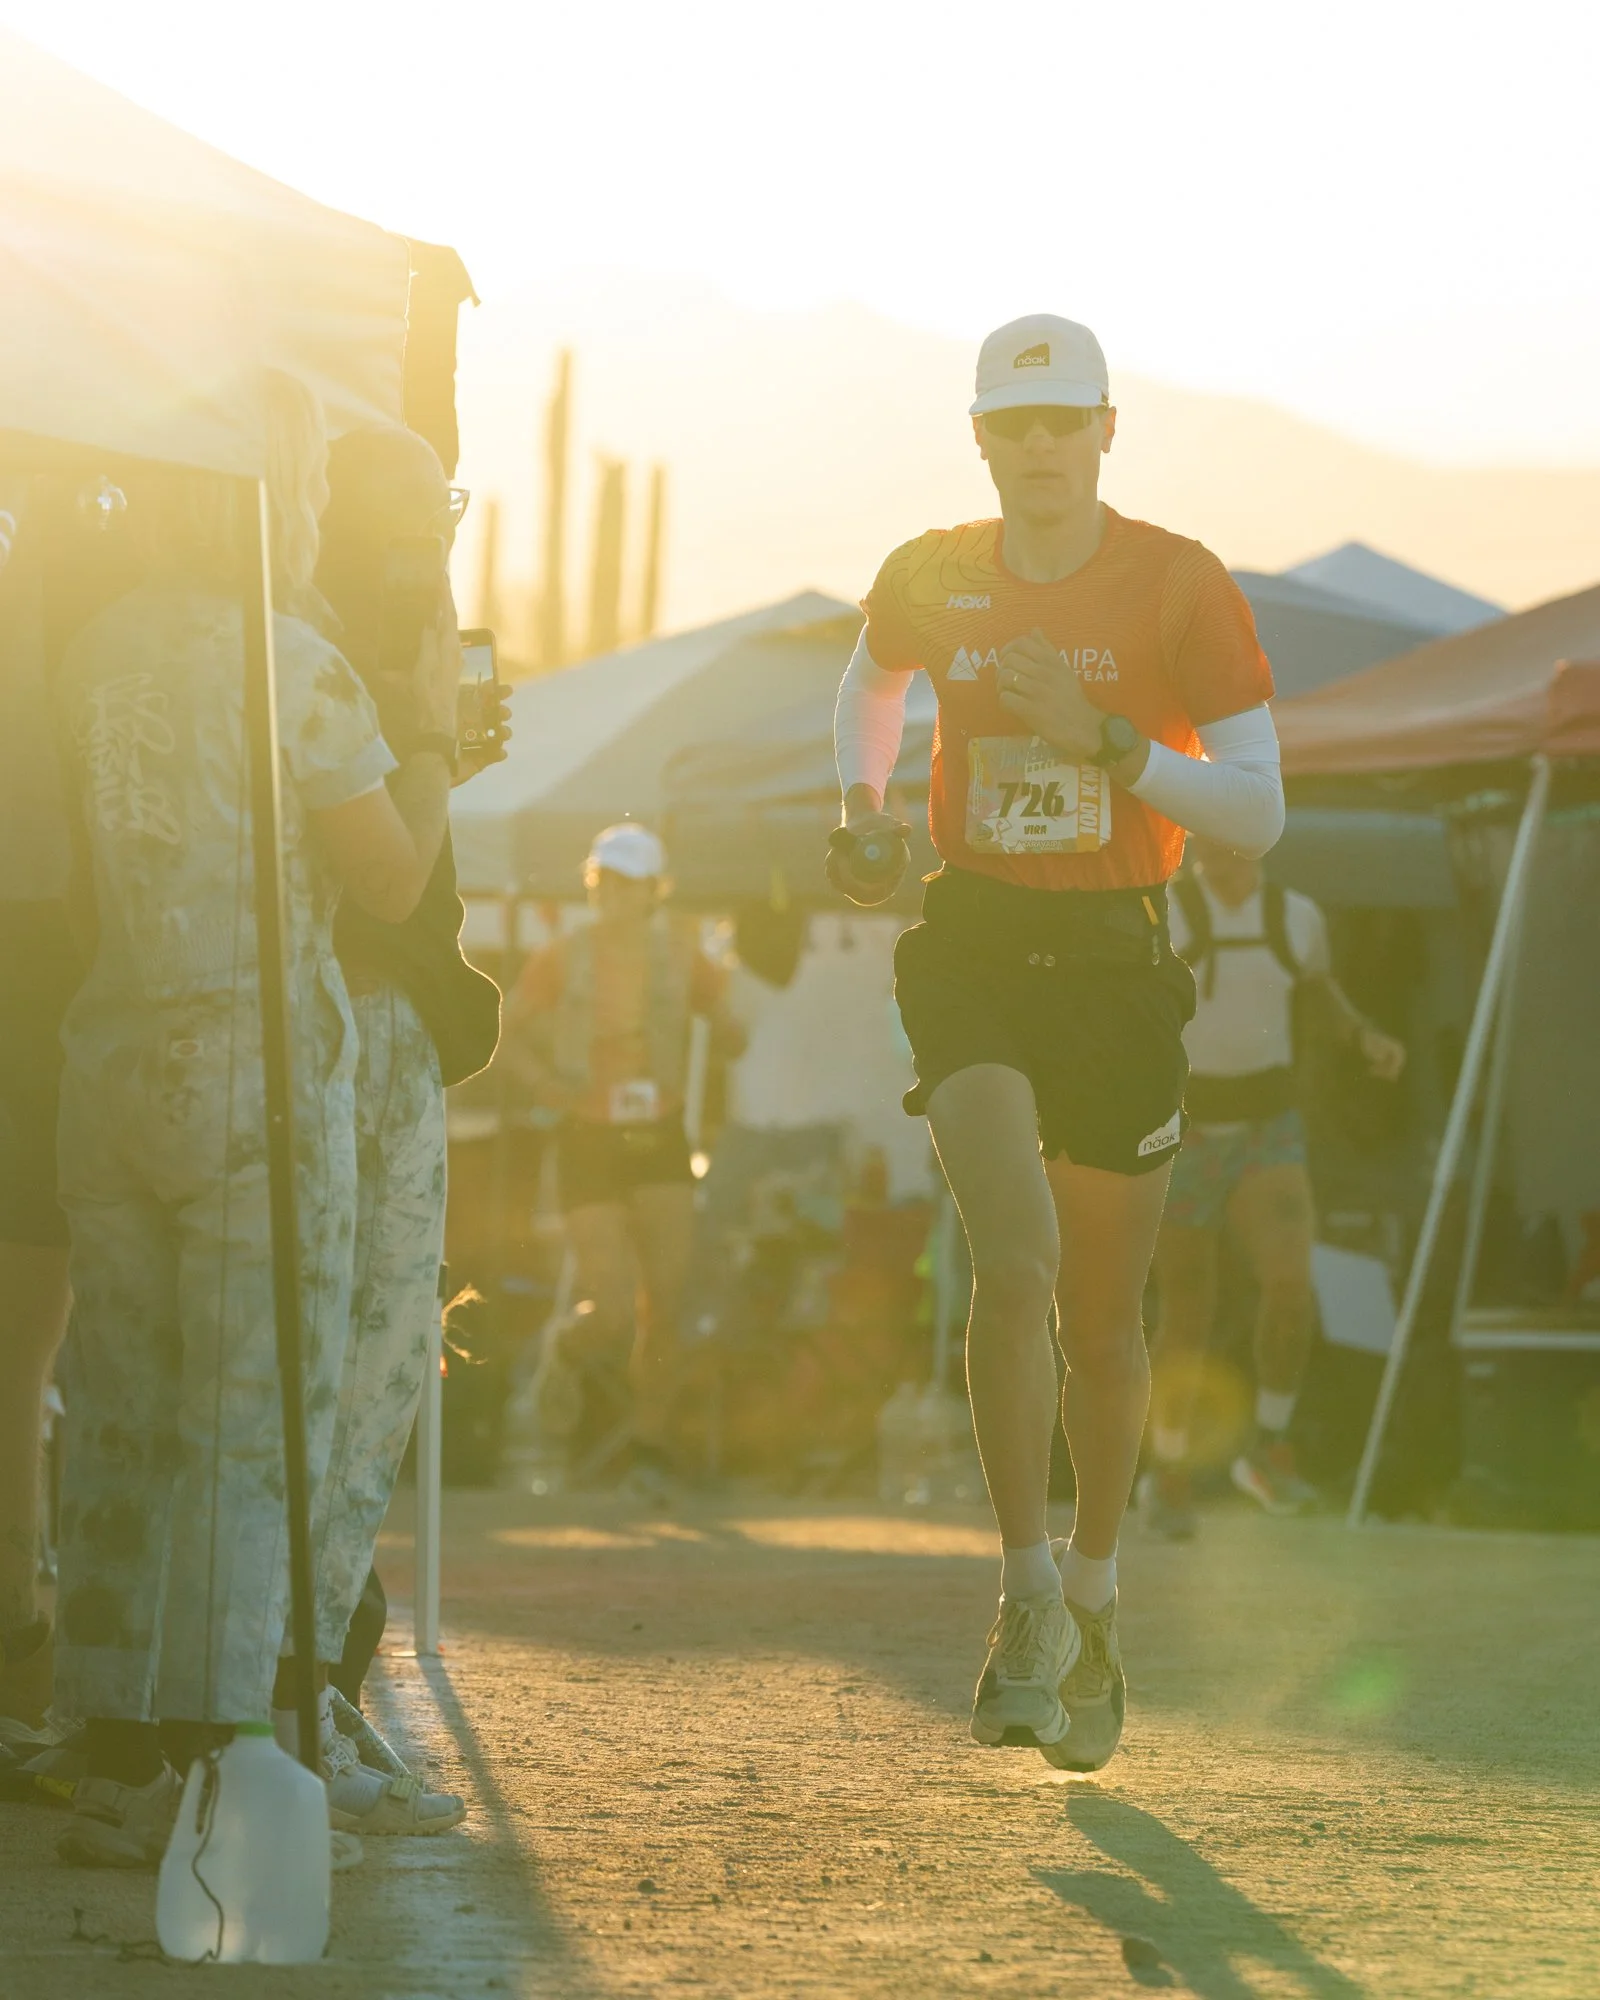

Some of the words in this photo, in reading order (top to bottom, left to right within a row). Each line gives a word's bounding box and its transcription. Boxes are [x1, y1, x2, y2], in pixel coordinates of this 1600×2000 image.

[946, 595, 991, 609] HOKA
[1079, 764, 1100, 797] KM
[997, 781, 1065, 818] 726
[1023, 824, 1048, 835] VIRA
[1079, 801, 1098, 834] 100
[1143, 1133, 1176, 1151] näak
